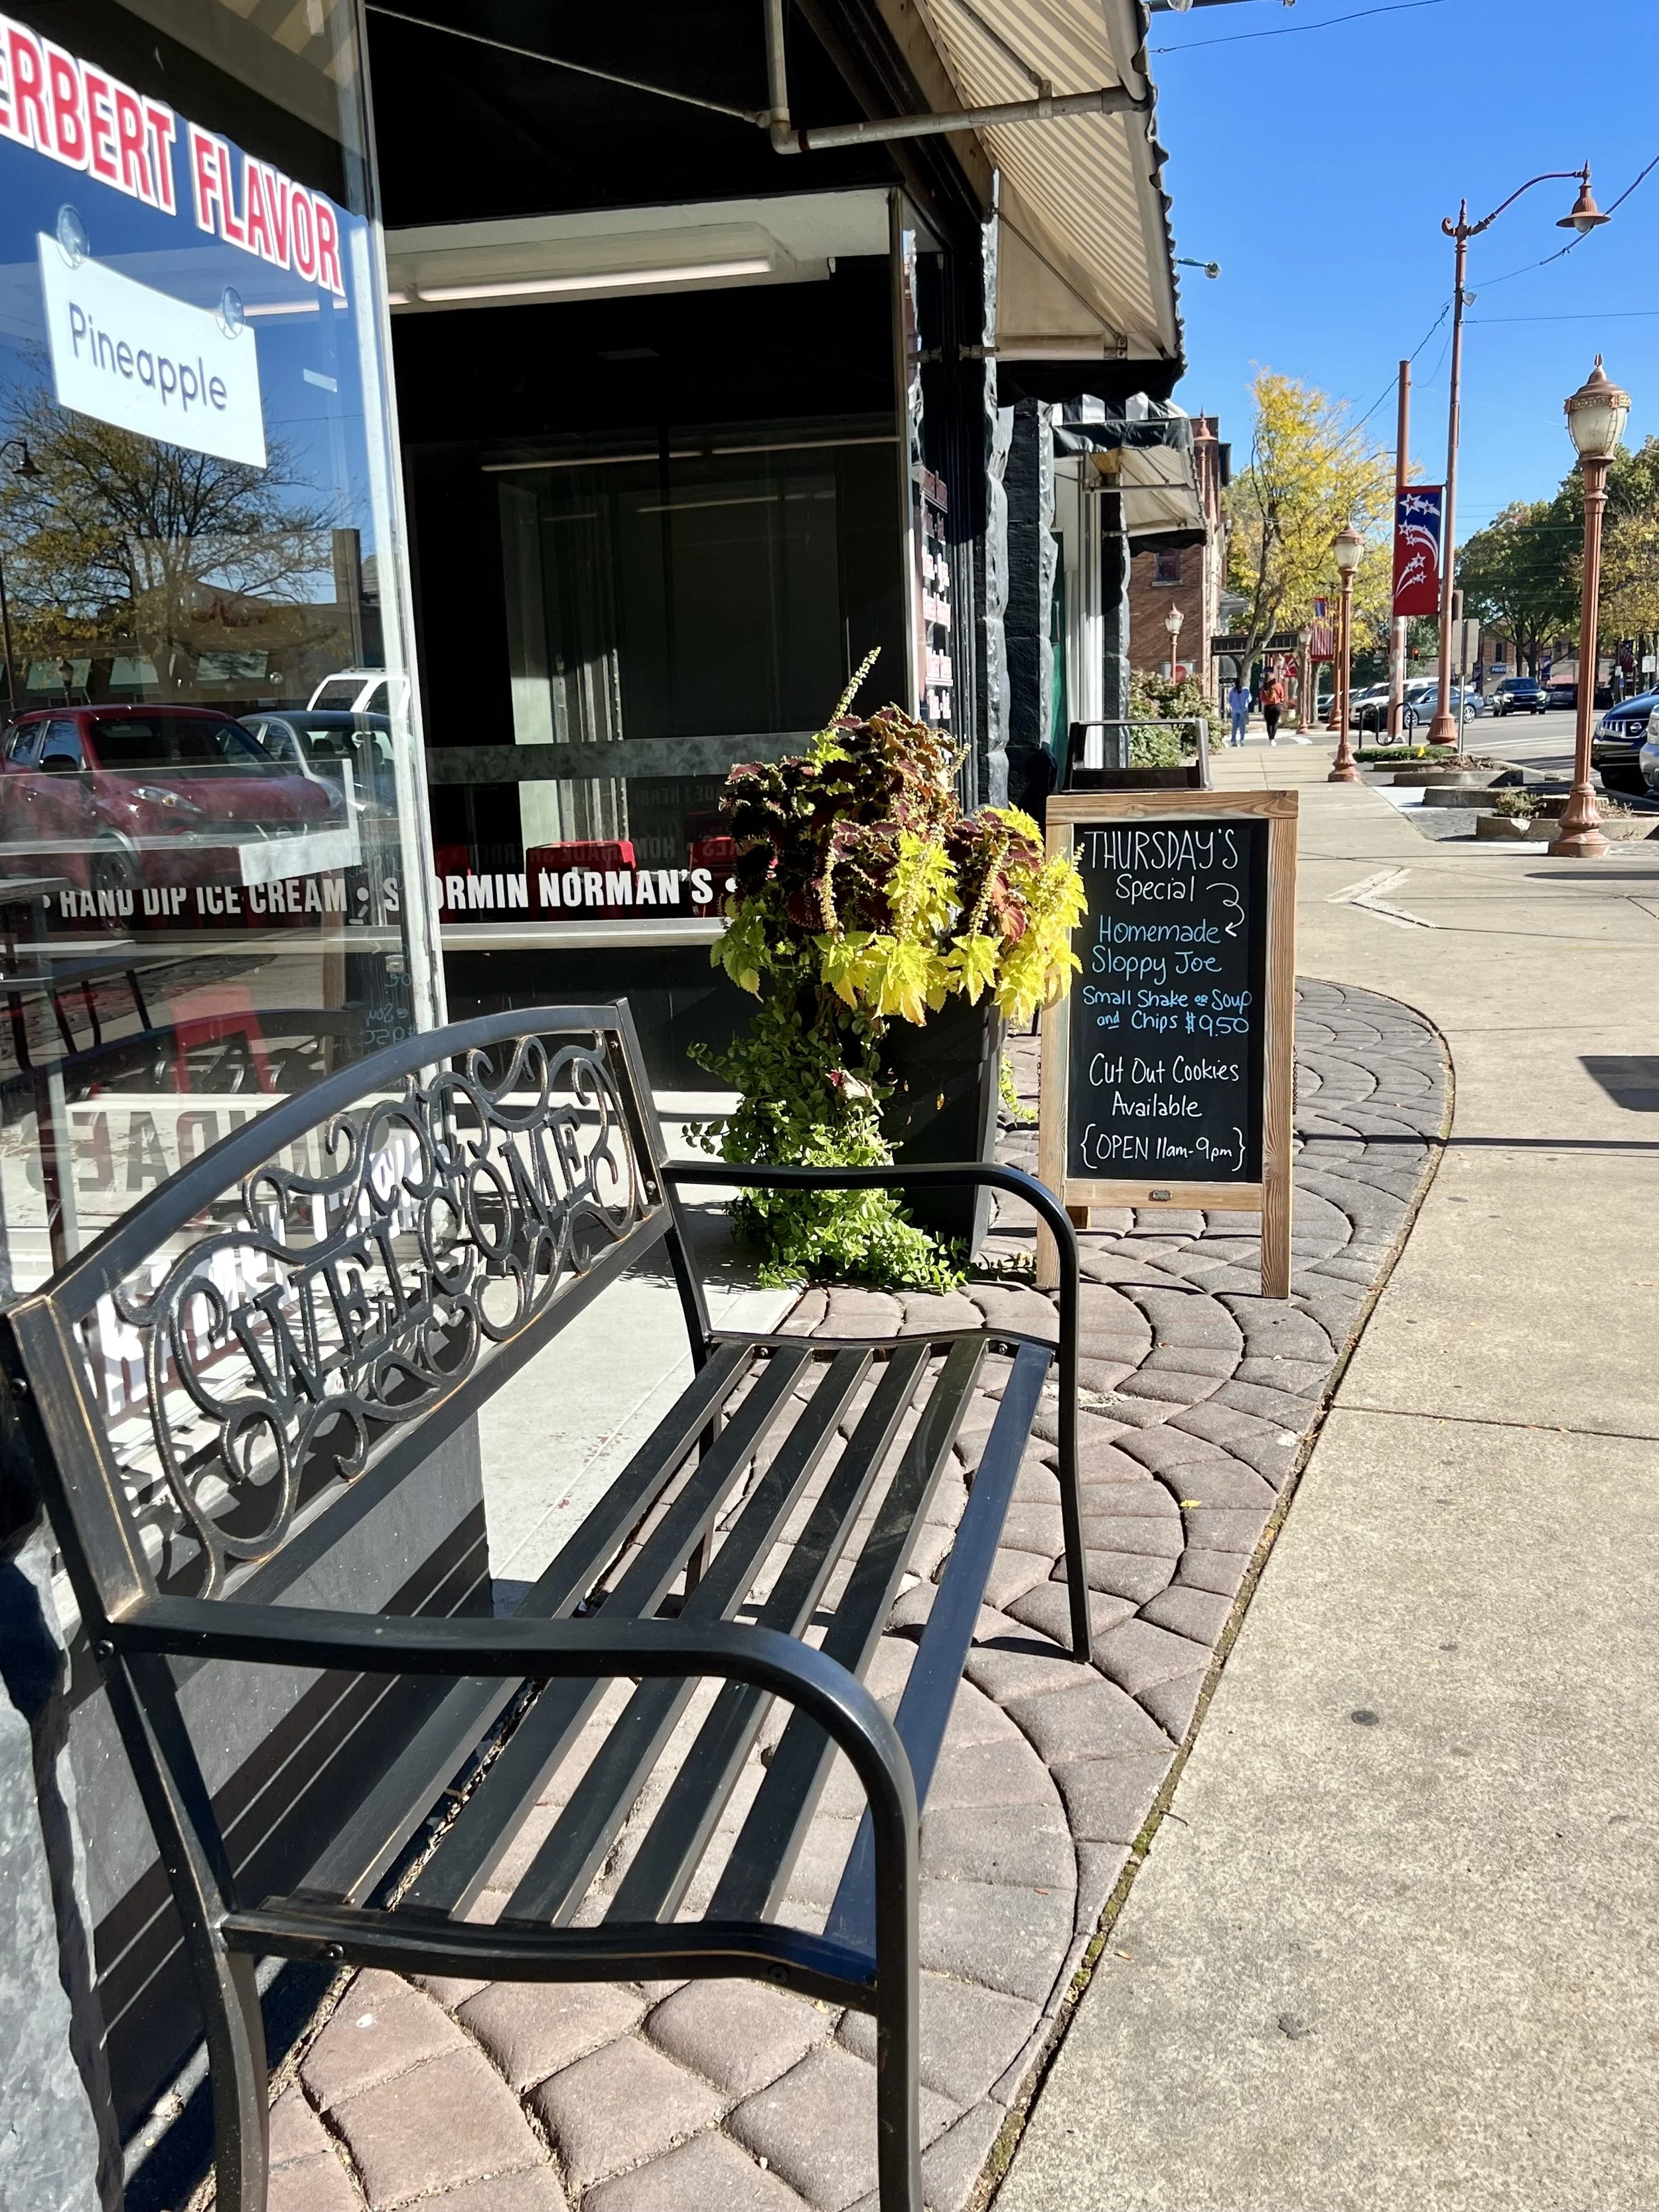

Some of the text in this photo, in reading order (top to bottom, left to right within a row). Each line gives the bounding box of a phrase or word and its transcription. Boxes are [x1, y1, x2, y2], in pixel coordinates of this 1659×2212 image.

[187, 121, 345, 297] FLAVOR
[68, 302, 228, 413] Pineapple
[1084, 828, 1239, 871] THURSDAY'S
[60, 887, 135, 919] HAND
[143, 886, 188, 917] DIP
[195, 885, 242, 916] ICE
[249, 878, 348, 915] CREAM
[538, 867, 714, 909] NORMAN'S
[1115, 873, 1195, 905] Special
[1099, 915, 1222, 944] Homemade
[1091, 944, 1222, 986] Sloppy Joe
[1082, 986, 1131, 1006] Small
[1137, 989, 1189, 1008] Shake
[1211, 988, 1253, 1015] Soup
[1097, 1011, 1250, 1037] and Chips $9.50
[1089, 1052, 1240, 1086] Cut Out Cookies
[1112, 1090, 1203, 1118] Available
[231, 1103, 595, 1404] WELCOME
